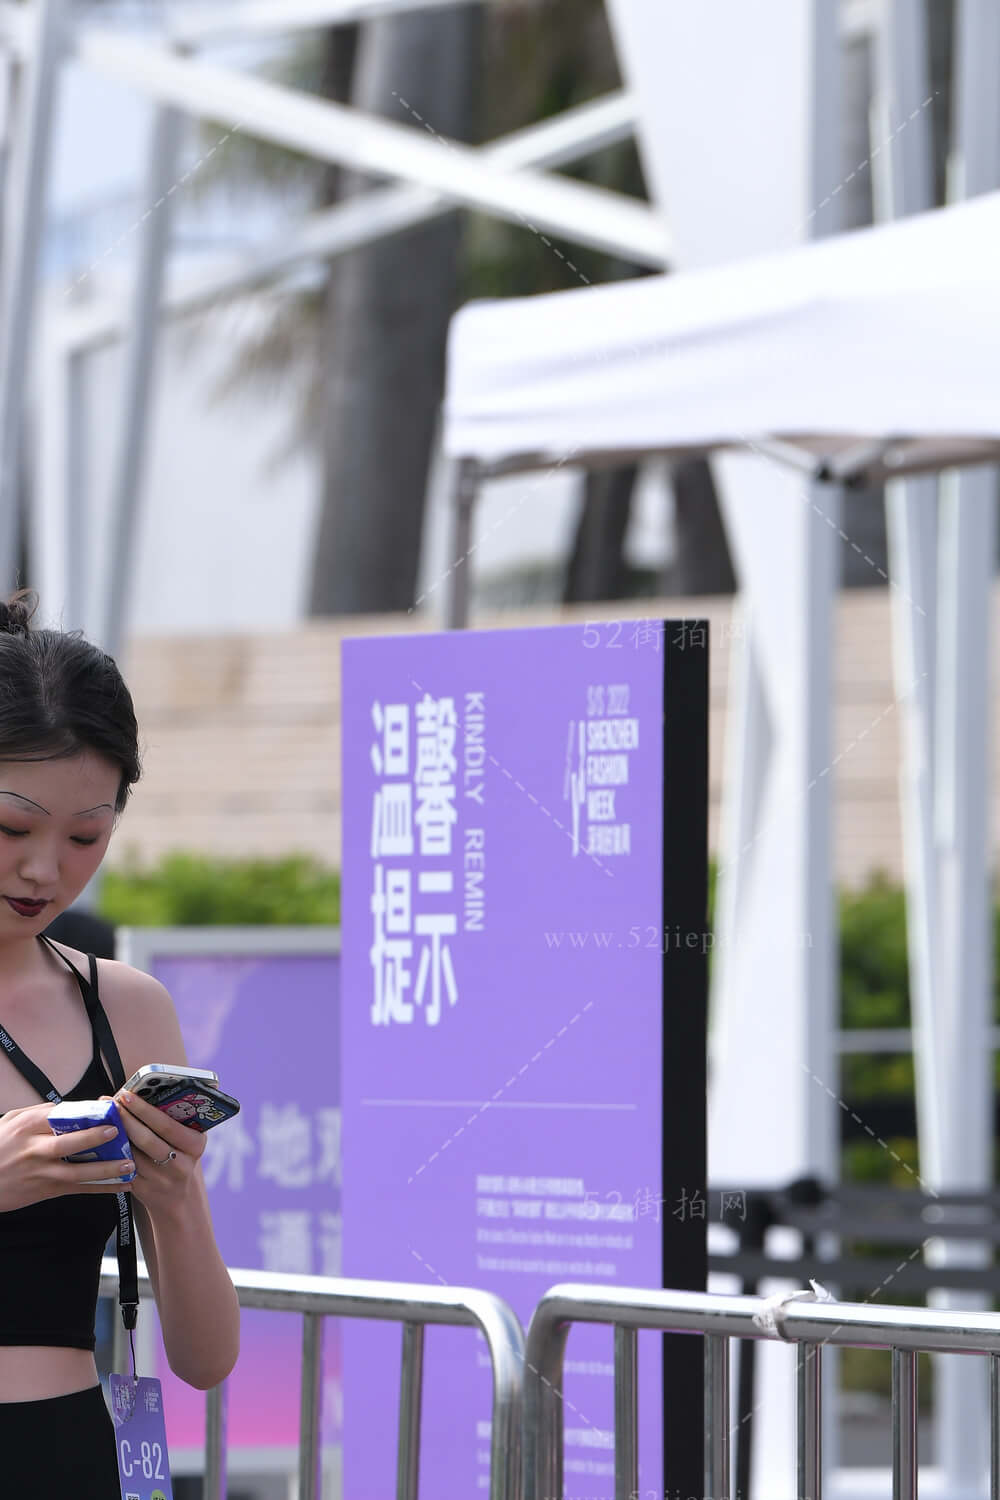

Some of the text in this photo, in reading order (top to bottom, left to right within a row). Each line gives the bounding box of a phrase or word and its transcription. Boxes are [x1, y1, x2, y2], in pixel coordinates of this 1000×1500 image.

[370, 692, 458, 860] 温馨
[464, 692, 486, 932] KINDLY REMIN
[370, 863, 459, 1026] 提示
[120, 1440, 165, 1480] C-82
